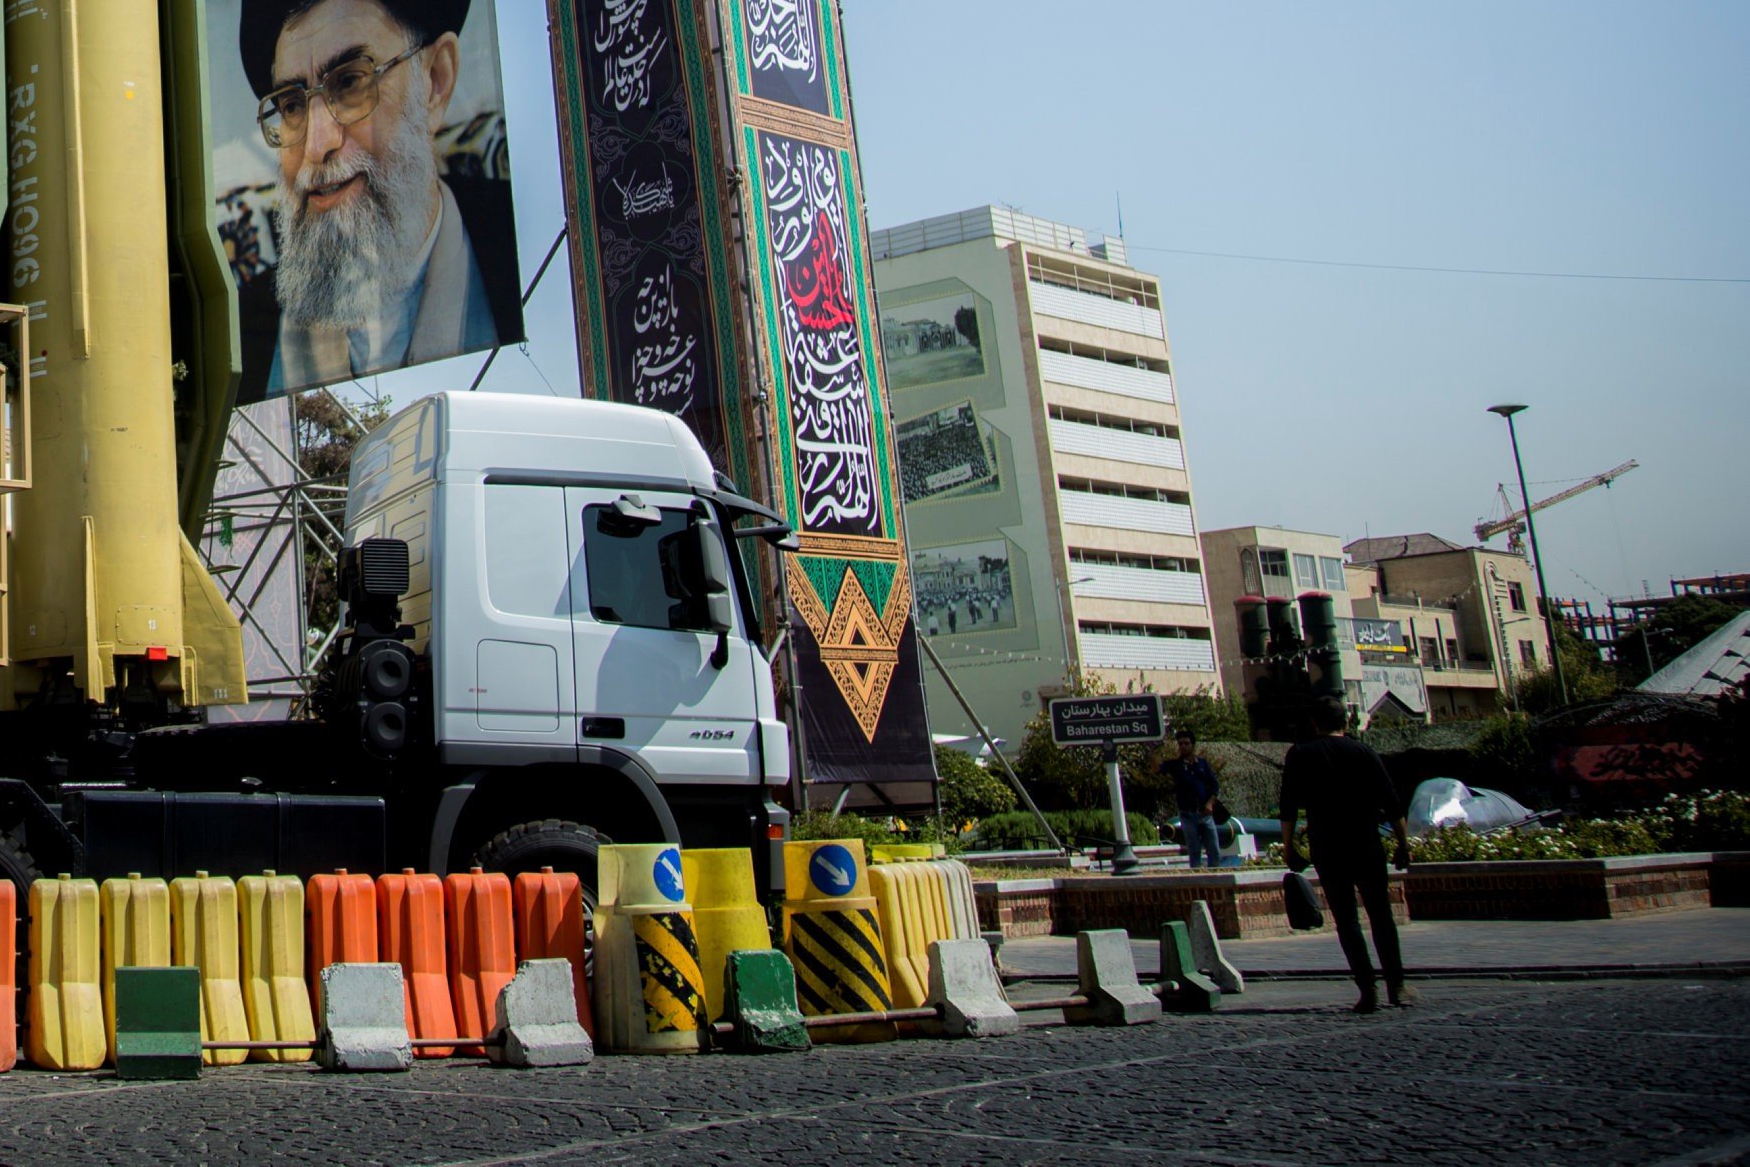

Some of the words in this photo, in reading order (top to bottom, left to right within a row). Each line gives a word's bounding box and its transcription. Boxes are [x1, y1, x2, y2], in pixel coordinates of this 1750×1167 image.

[1061, 703, 1111, 719] بهارستان
[1113, 701, 1149, 716] میدان
[1066, 723, 1130, 736] Baharestan
[1132, 721, 1149, 734] Sq
